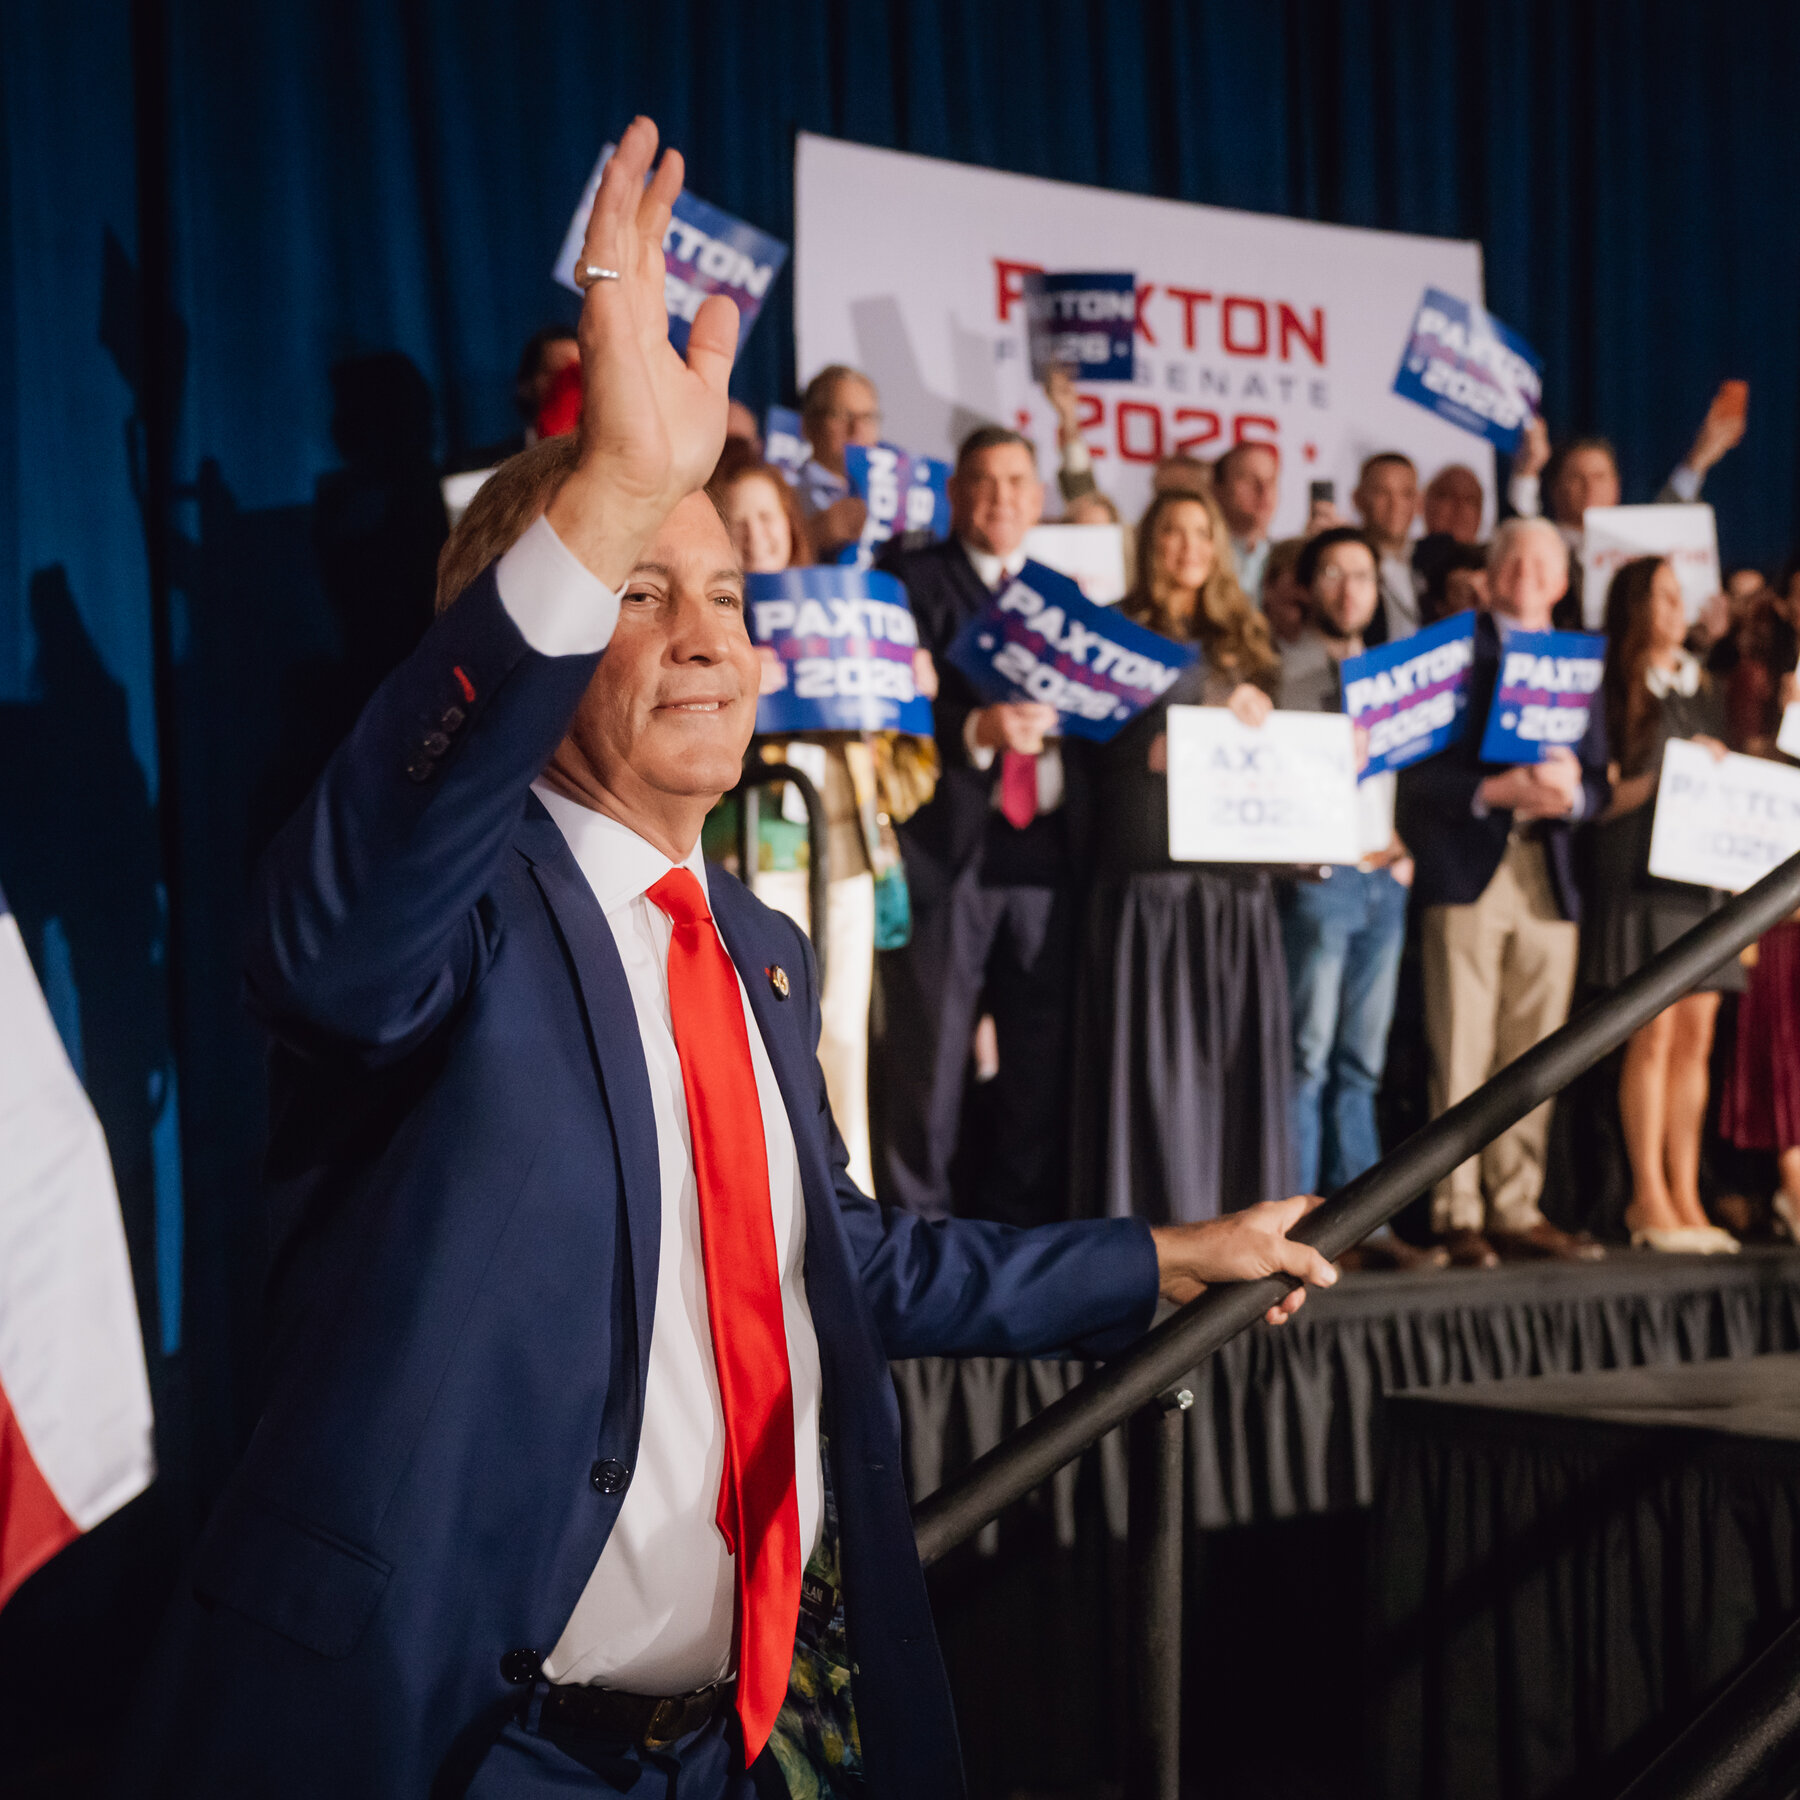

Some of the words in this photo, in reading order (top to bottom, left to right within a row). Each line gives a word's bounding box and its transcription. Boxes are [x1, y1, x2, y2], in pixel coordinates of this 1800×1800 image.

[754, 598, 920, 647] PAXTO
[998, 578, 1181, 695] PAXTON
[992, 642, 1120, 721] 2026
